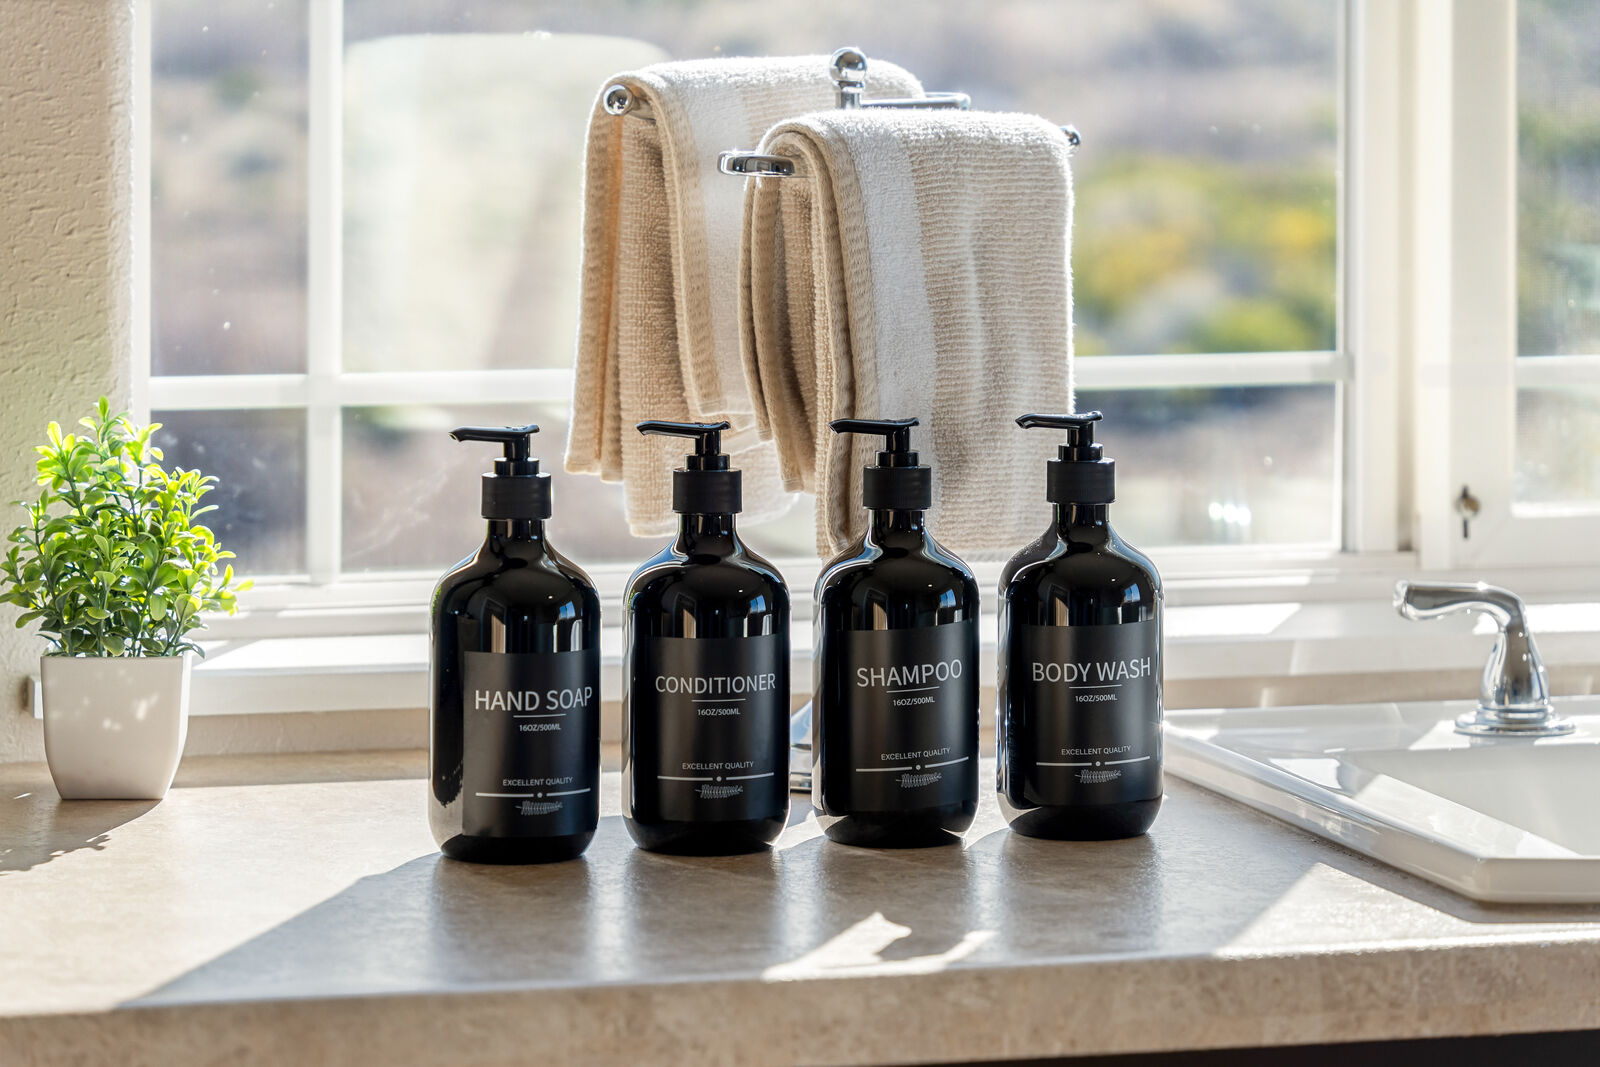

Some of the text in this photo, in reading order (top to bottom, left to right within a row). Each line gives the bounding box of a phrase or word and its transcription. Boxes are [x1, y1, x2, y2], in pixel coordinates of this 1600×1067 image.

[856, 659, 962, 687] SHAMPOO
[1032, 656, 1151, 682] BODY WASH
[655, 673, 776, 694] CONDITIONER
[475, 686, 592, 711] HAND SOAP
[893, 696, 936, 707] 16OZ/500ML
[1075, 694, 1118, 703] 16OZ/500ML
[697, 708, 741, 716] 16OZ/500ML
[519, 723, 562, 732] 16OZ/500ML
[881, 747, 951, 761] EXCELLENT QUALITY
[1061, 745, 1132, 756] EXCELLENT QUALITY
[725, 761, 754, 770] QUALITY
[502, 776, 574, 787] EXCELLENT QUALITY
